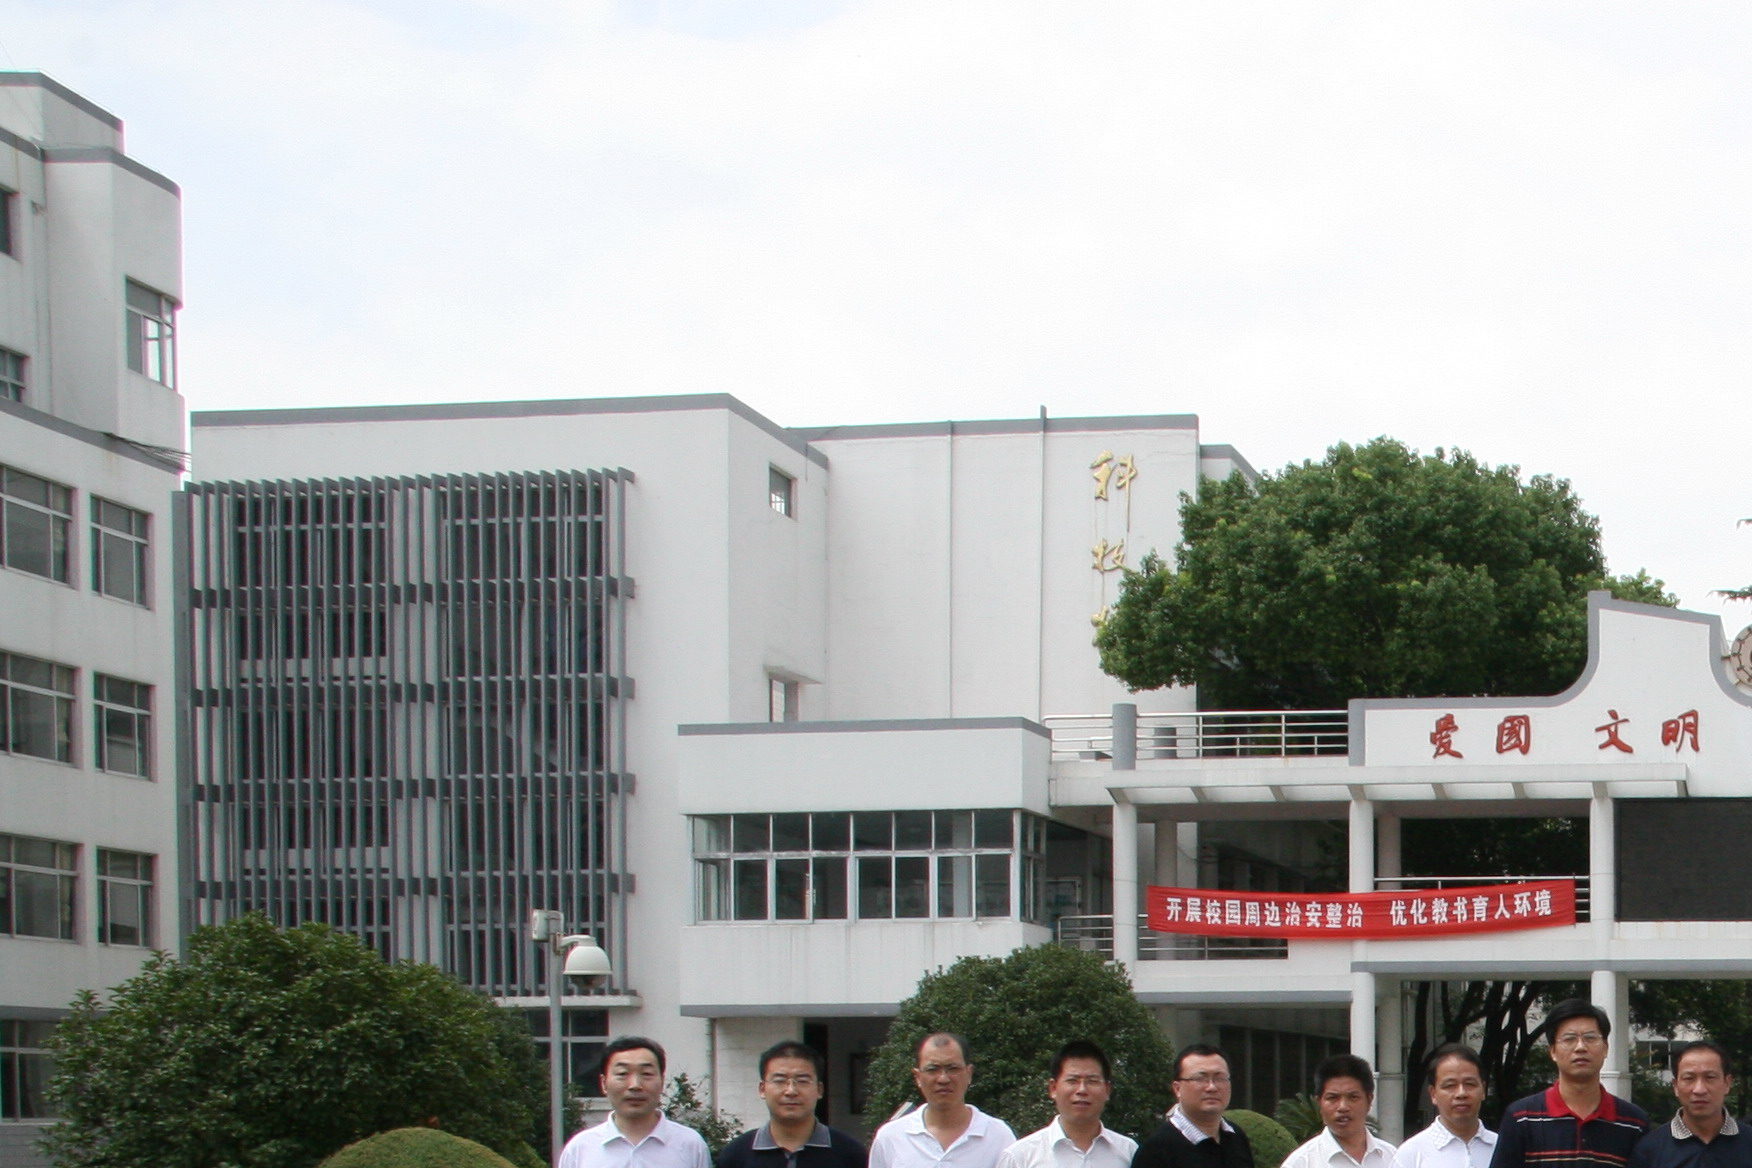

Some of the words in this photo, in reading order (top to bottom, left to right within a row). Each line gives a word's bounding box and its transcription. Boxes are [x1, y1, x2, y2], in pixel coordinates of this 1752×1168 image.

[1090, 449, 1138, 647] 科技
[1595, 709, 1699, 753] 文明
[1166, 897, 1363, 928] 开展校园周边治安整治
[1389, 890, 1552, 926] 优化教书育人环境
